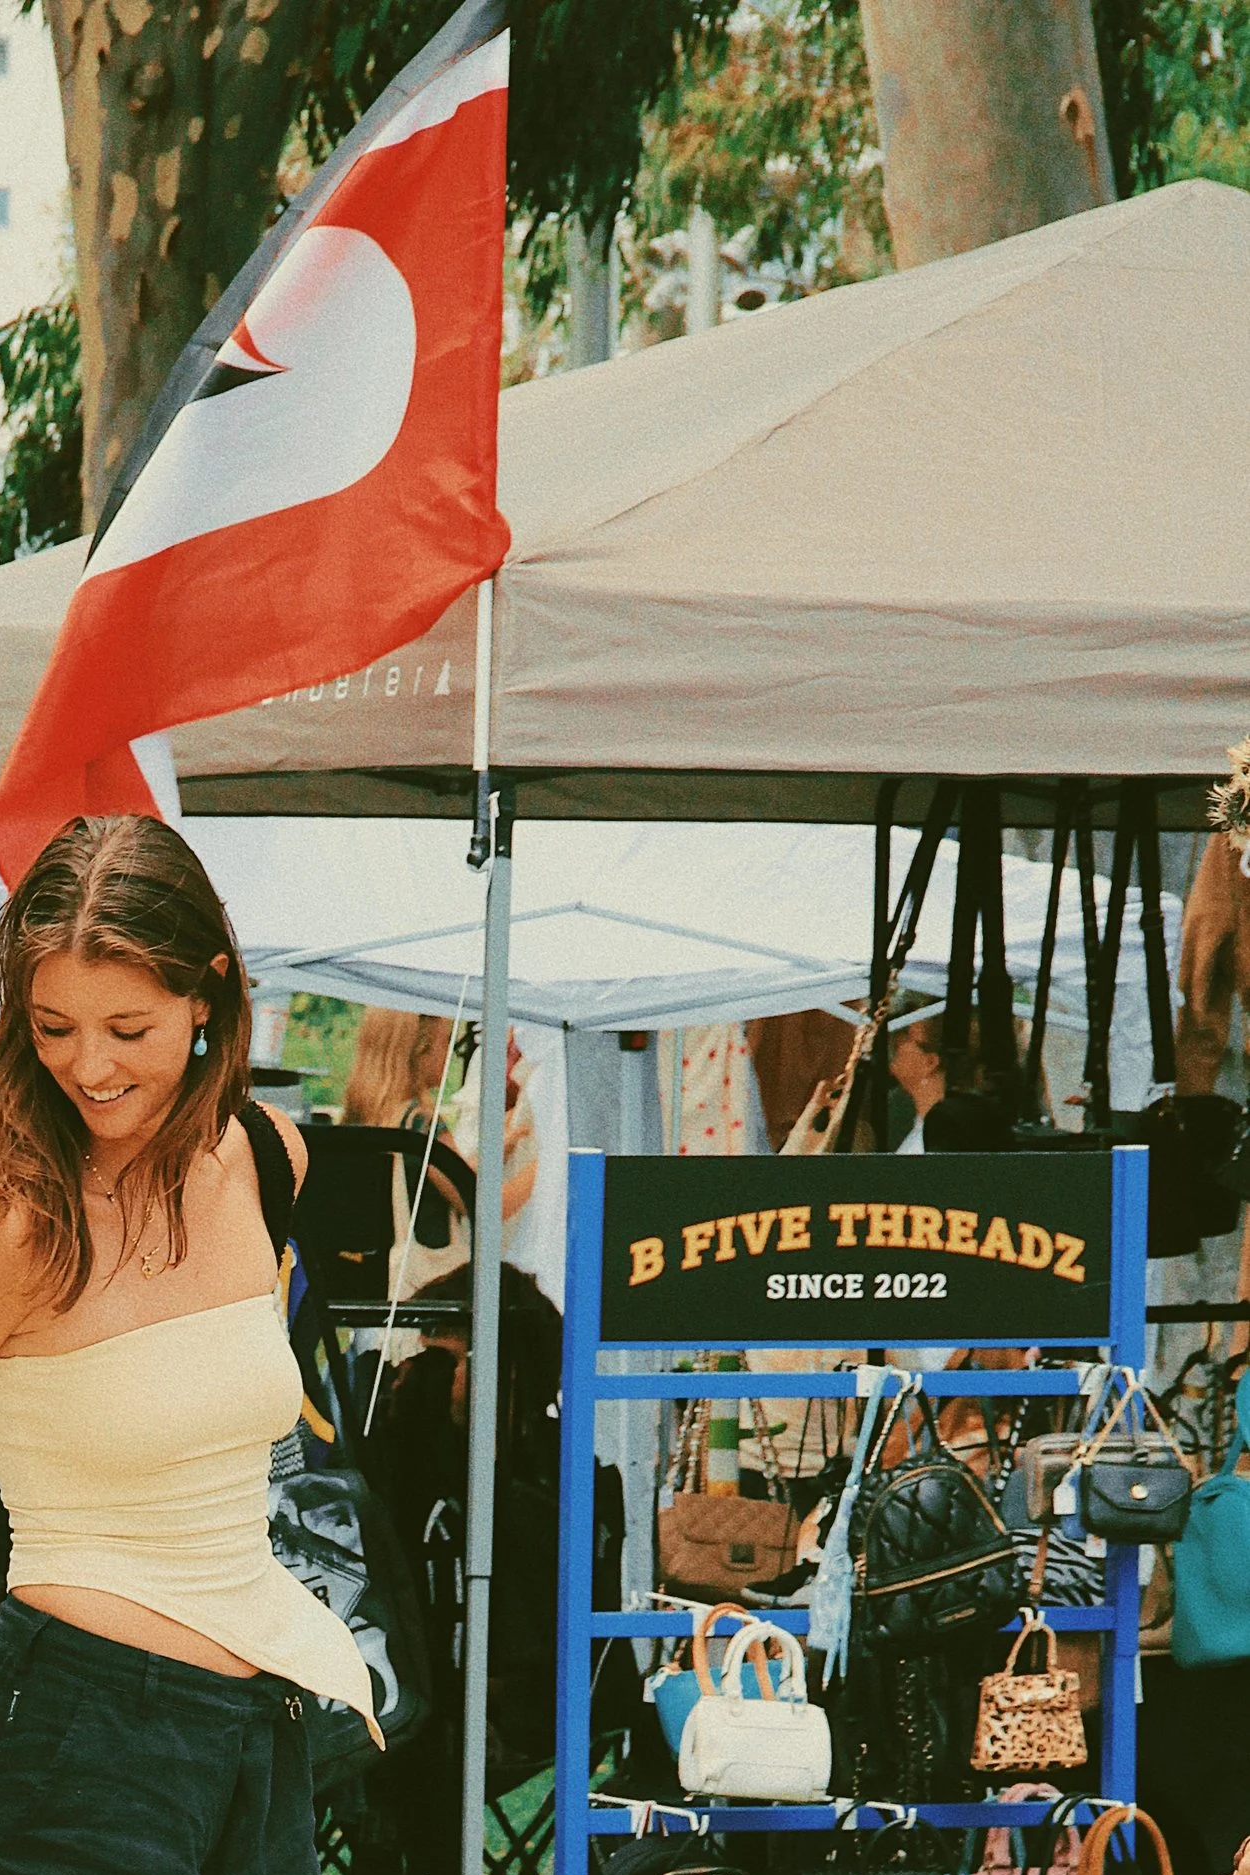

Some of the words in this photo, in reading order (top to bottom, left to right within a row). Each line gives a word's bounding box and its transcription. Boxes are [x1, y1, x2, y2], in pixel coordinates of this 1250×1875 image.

[628, 1236, 666, 1287] B
[680, 1205, 812, 1272] FIVE
[827, 1202, 1087, 1284] THREADZ
[765, 1273, 865, 1300] SINCE
[873, 1272, 949, 1300] 2022
